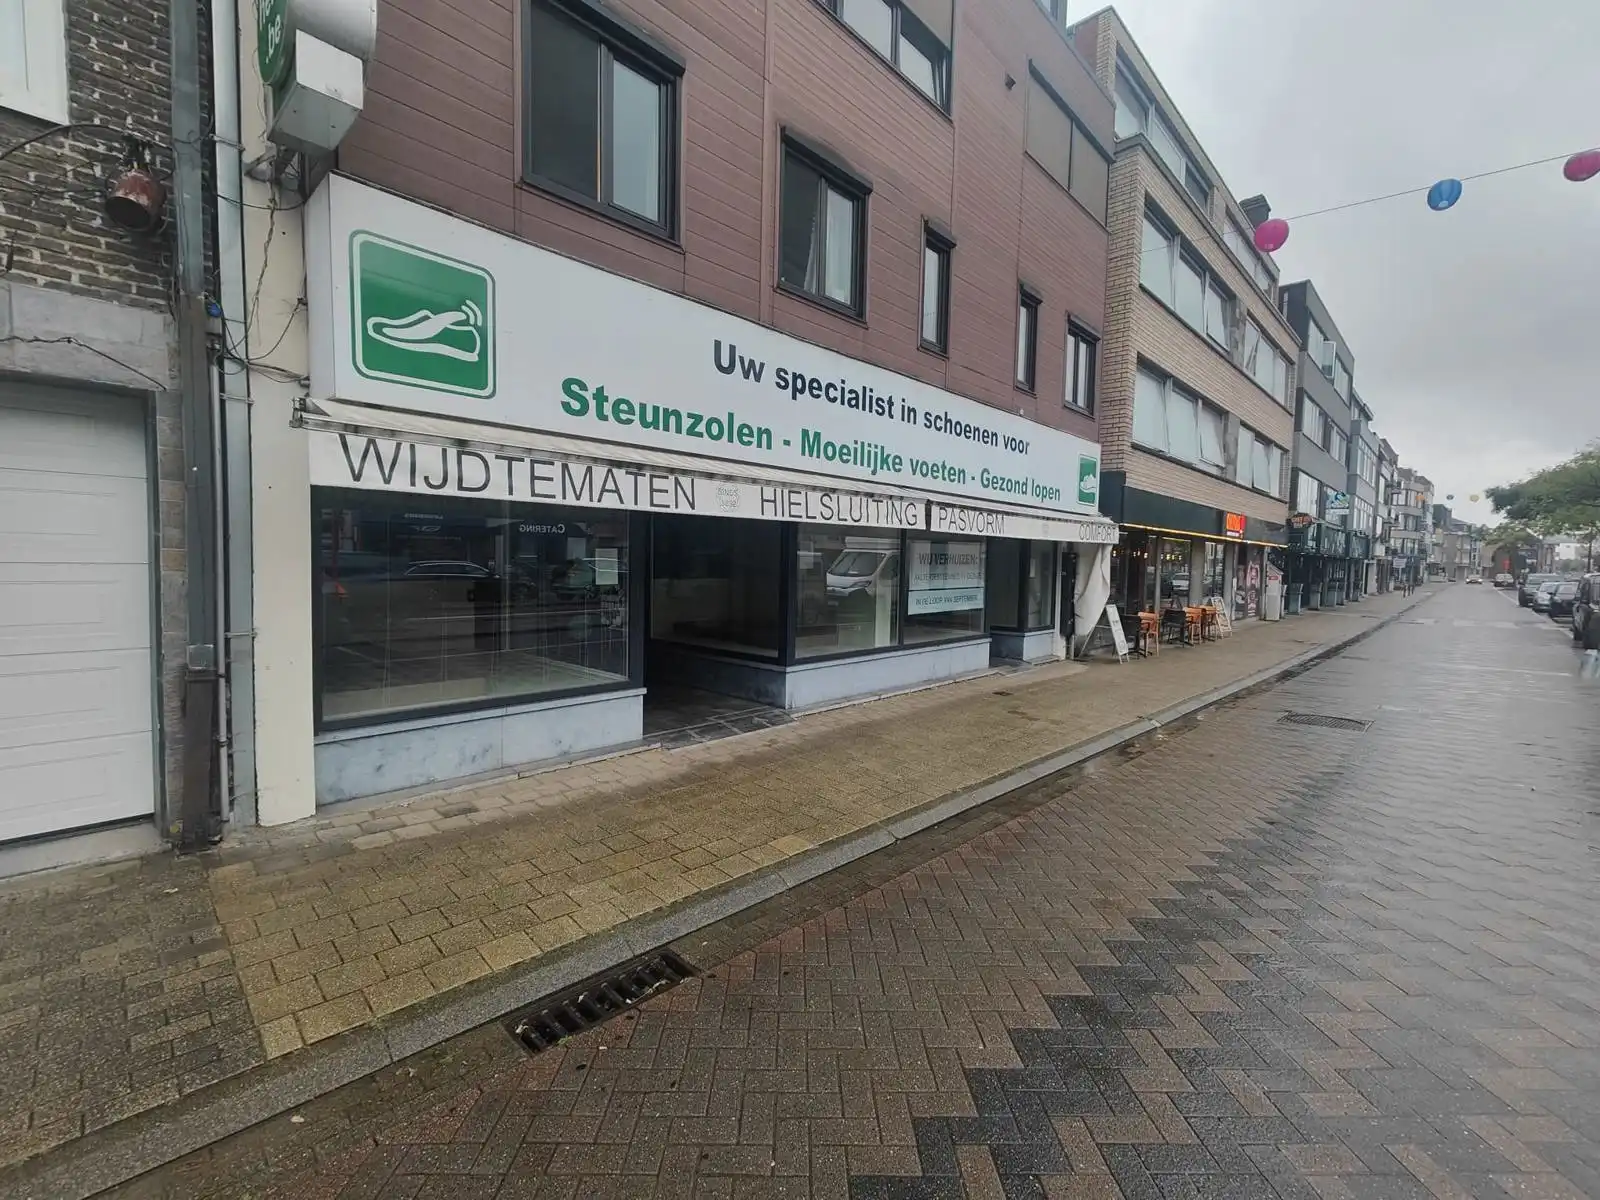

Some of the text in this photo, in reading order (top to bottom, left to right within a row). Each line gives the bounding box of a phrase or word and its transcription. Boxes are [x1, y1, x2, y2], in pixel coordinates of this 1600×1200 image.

[713, 339, 1030, 455] Uw specialist in schoenen voor
[560, 377, 772, 450] Steunzolen
[801, 428, 903, 475] Moeilijke
[909, 456, 966, 484] voeten
[980, 468, 1028, 495] Gezond
[1031, 478, 1061, 502] lopen
[338, 433, 696, 511] WIJDTEMATEN
[760, 486, 918, 526] HIELSLUITING
[938, 506, 1005, 535] PASVORM
[1079, 523, 1117, 542] COMFORT
